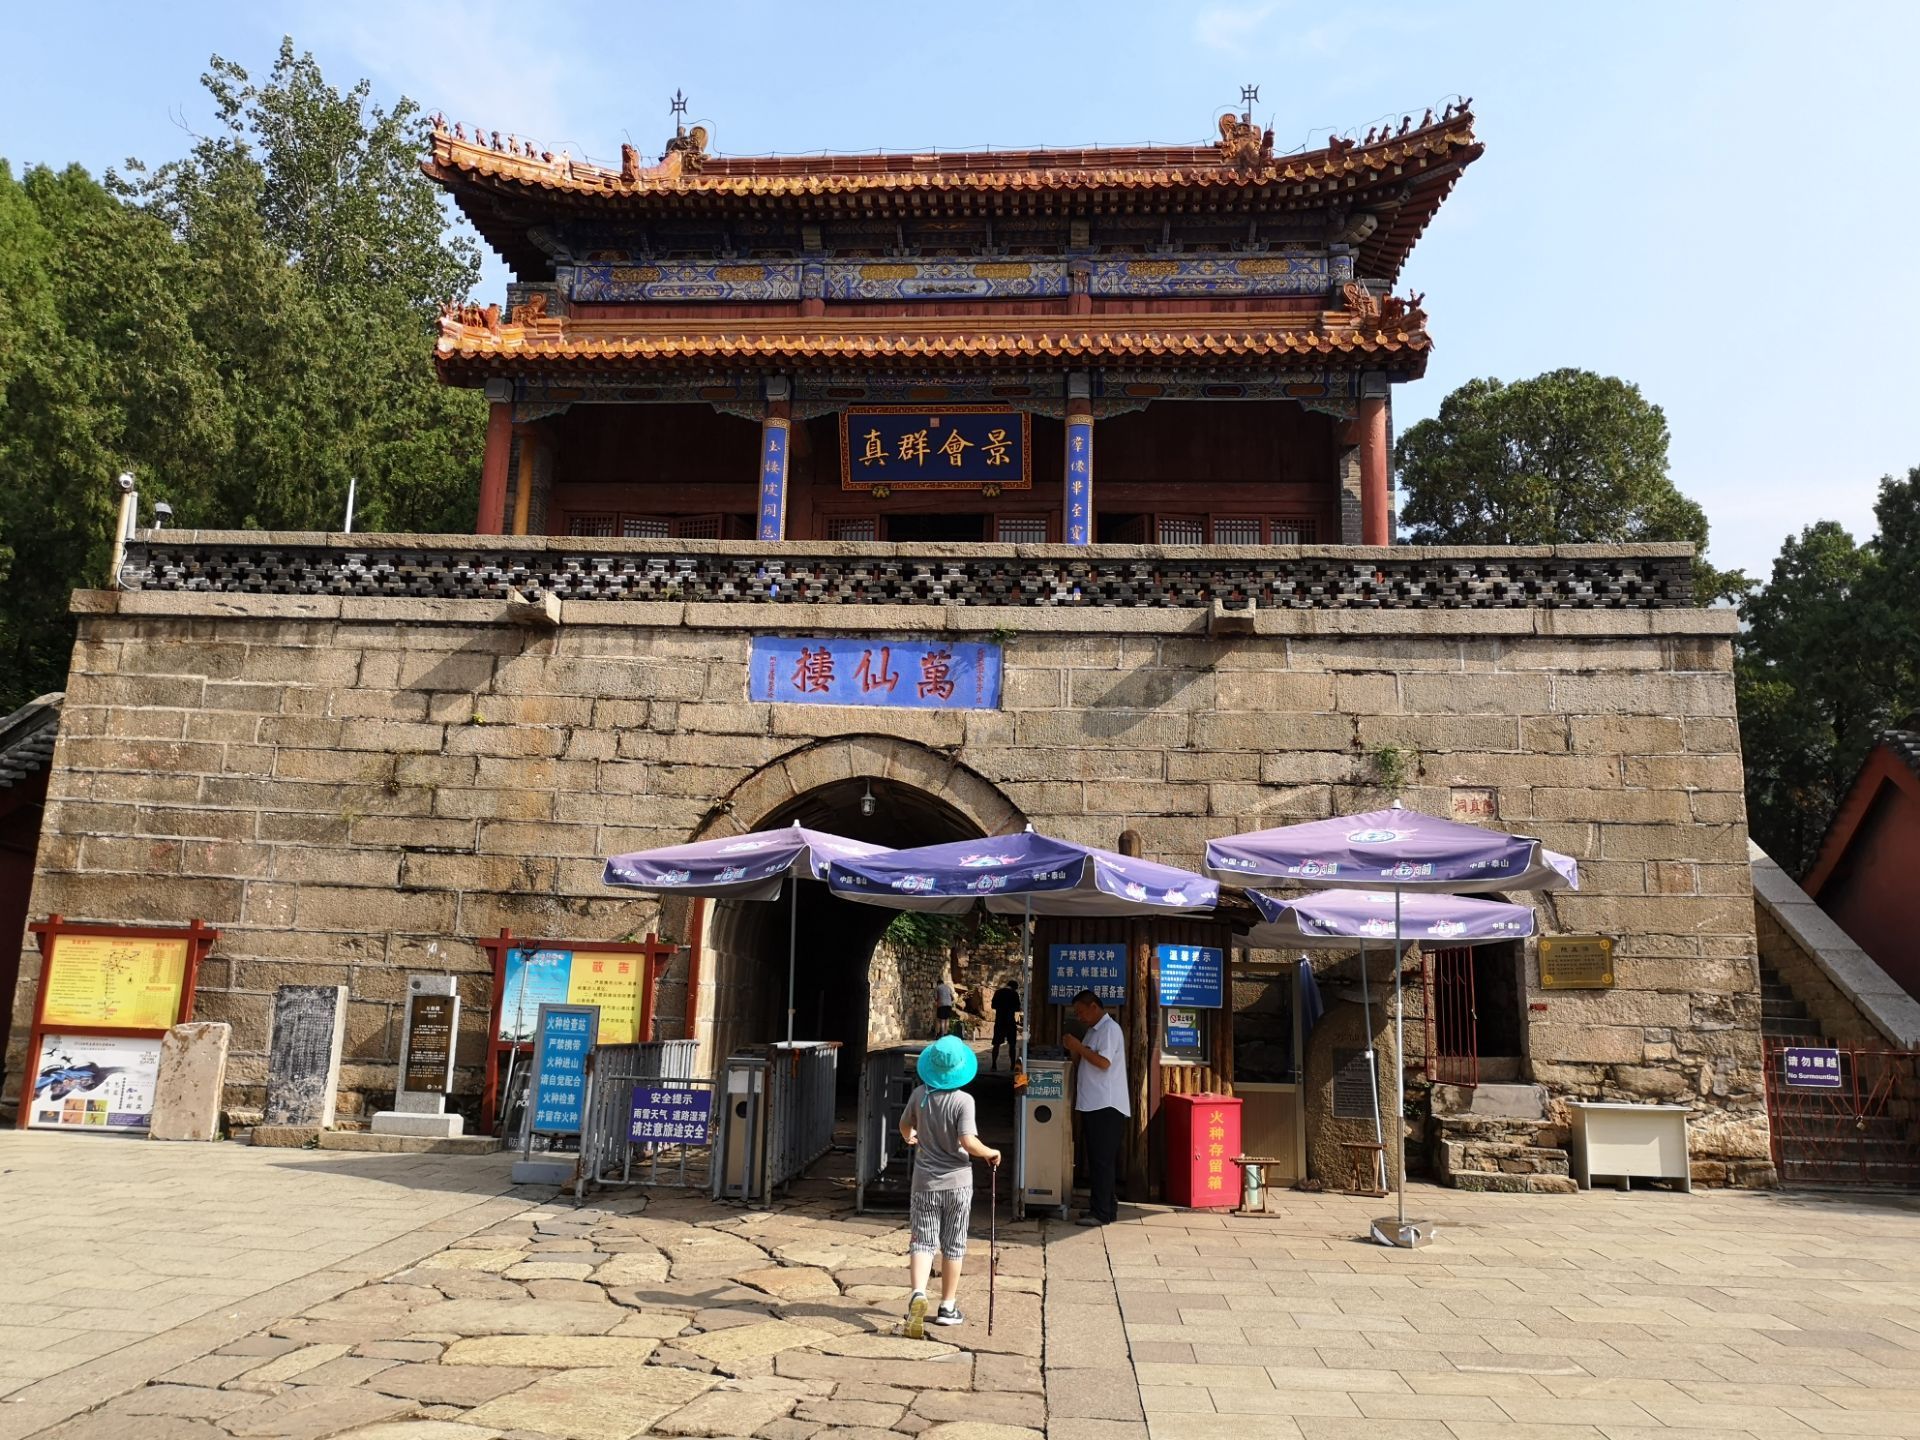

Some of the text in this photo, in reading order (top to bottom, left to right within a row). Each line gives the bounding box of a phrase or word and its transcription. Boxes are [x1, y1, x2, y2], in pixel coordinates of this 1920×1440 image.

[1060, 949, 1115, 961] 严禁携带火种
[546, 1016, 587, 1031] 火种检查站
[548, 1038, 581, 1051] 严禁携带
[546, 1057, 579, 1069] 火种进山
[1787, 1056, 1837, 1068] 请勿翻越
[540, 1074, 582, 1087] 请自觉配合
[1798, 1073, 1839, 1082] Surmounting
[542, 1092, 576, 1105] 火种检查
[651, 1092, 693, 1105] 安全提示
[536, 1110, 579, 1124] 并留存火种
[633, 1108, 707, 1122] 雨雪天气 道路湿滑
[631, 1121, 705, 1139] 请注意旅途安全
[1207, 1110, 1224, 1190] 火种存留箱
